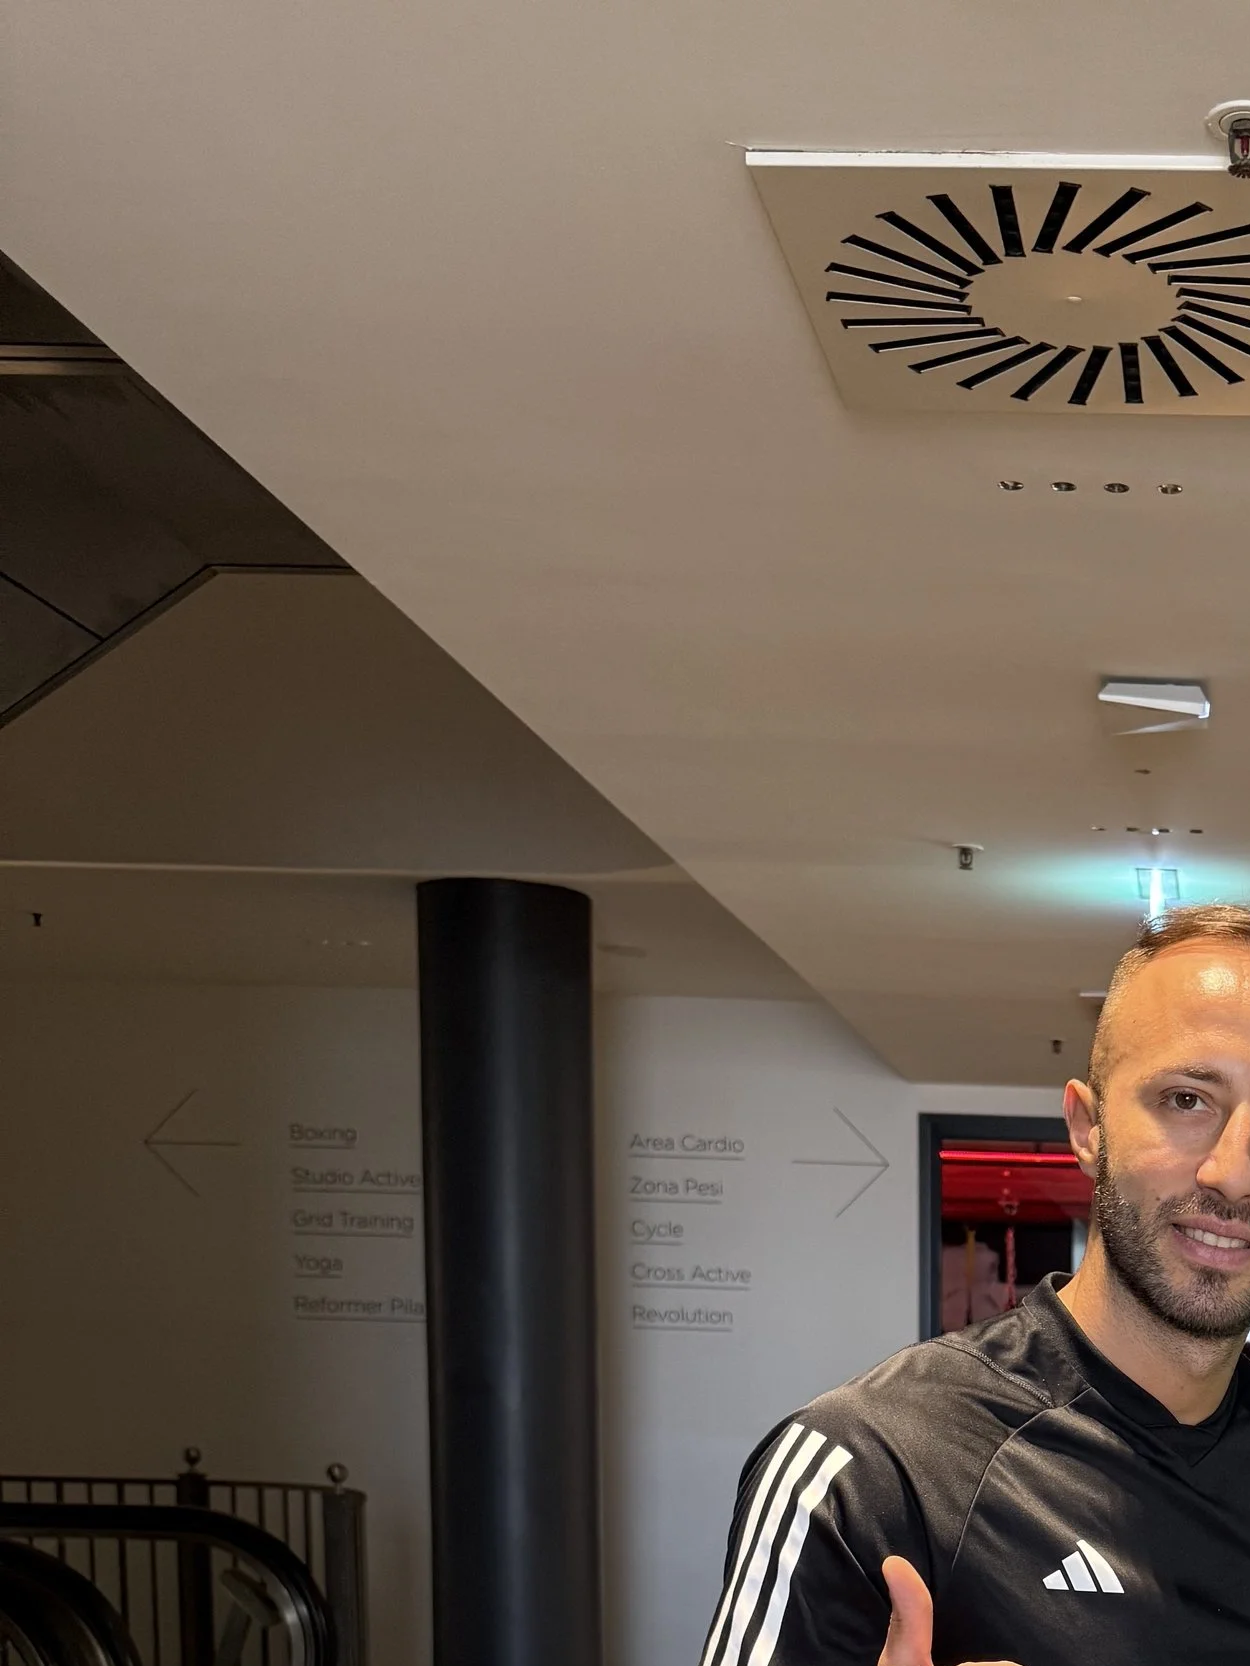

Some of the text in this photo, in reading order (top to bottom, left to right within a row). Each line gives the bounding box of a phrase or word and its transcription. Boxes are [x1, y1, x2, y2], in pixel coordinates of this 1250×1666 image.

[289, 1123, 357, 1145] Boxing
[630, 1133, 745, 1153] Area Cardio
[290, 1166, 423, 1188] Studio Active
[630, 1176, 724, 1196] Zona Pesi
[292, 1208, 415, 1232] Grid Training
[631, 1219, 684, 1240] Cycle
[293, 1253, 344, 1275] Yoga
[630, 1262, 752, 1283] Cross Active
[293, 1294, 426, 1316] Reformer Pila
[632, 1304, 734, 1325] Revolution
